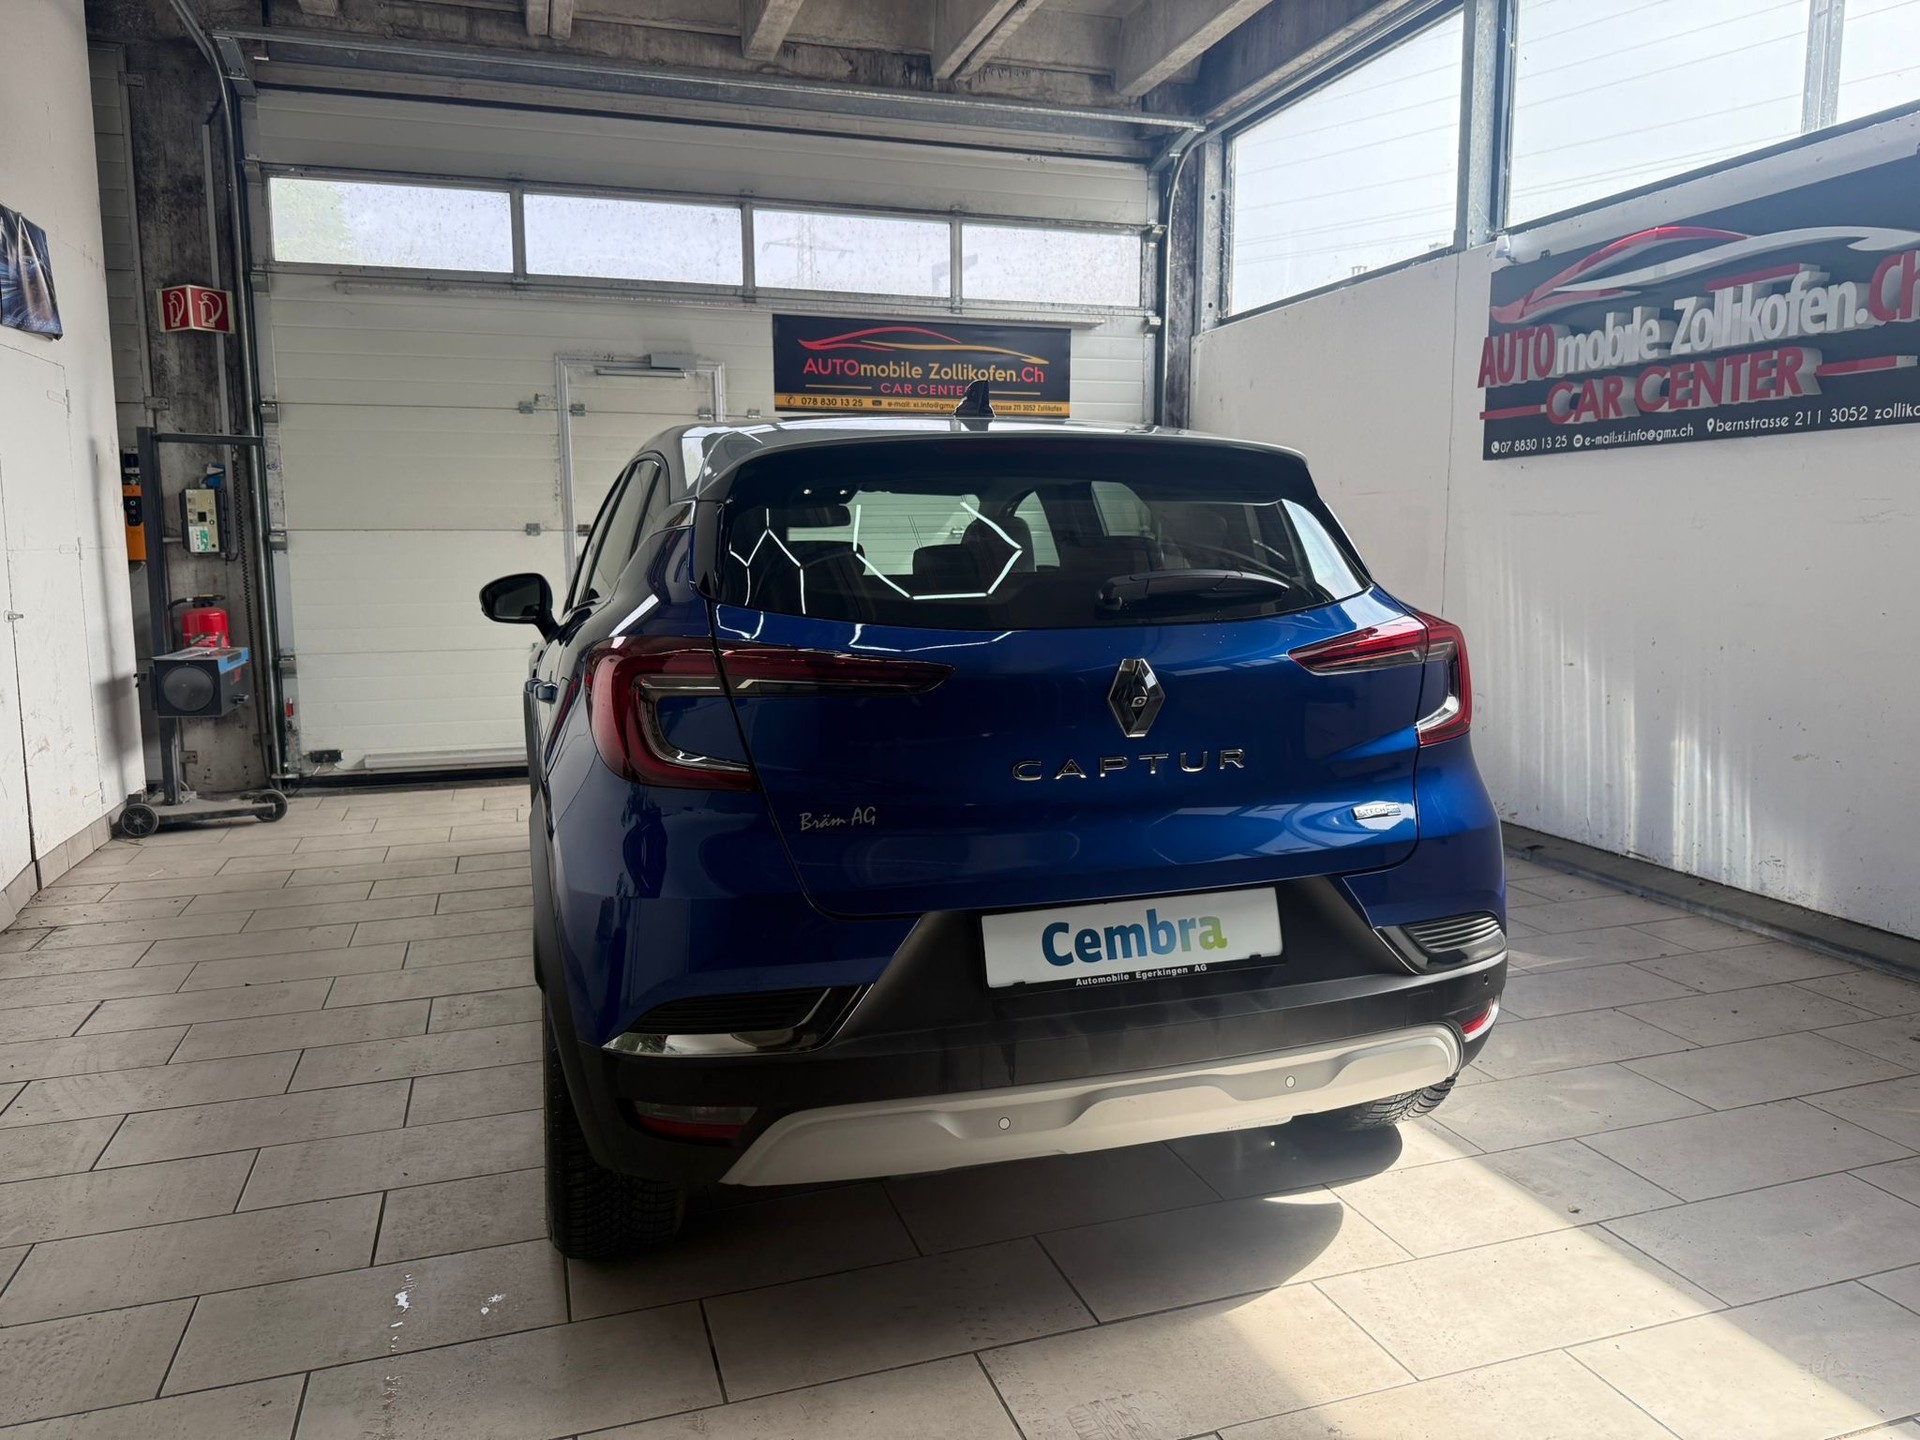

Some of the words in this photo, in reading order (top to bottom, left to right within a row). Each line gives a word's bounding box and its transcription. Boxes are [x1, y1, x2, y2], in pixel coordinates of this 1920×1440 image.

[1478, 306, 1661, 388] AUTOmobile
[803, 358, 922, 379] AUTOmobile
[928, 362, 1045, 383] Zollikofen.Ch
[880, 382, 913, 395] CAR
[917, 383, 968, 397] CENTE
[1546, 375, 1623, 424] CAR
[1634, 347, 1806, 412] CENTER
[801, 396, 818, 406] 078
[820, 397, 837, 407] 830
[840, 398, 850, 407] 13
[852, 398, 864, 408] 25
[1716, 416, 1789, 432] bernstrasse
[1829, 405, 1868, 423] 3052
[1500, 441, 1512, 453] 07
[1514, 438, 1537, 452] 8830
[1541, 436, 1552, 450] 13
[1555, 435, 1568, 448] 25
[1012, 748, 1245, 781] CAPTUR
[799, 812, 847, 831] Bräm
[851, 806, 877, 826] AG
[1041, 908, 1228, 967] Cembra
[1076, 973, 1130, 987] Automobile
[1136, 967, 1188, 980] Egerkingen
[1194, 963, 1208, 973] AG
